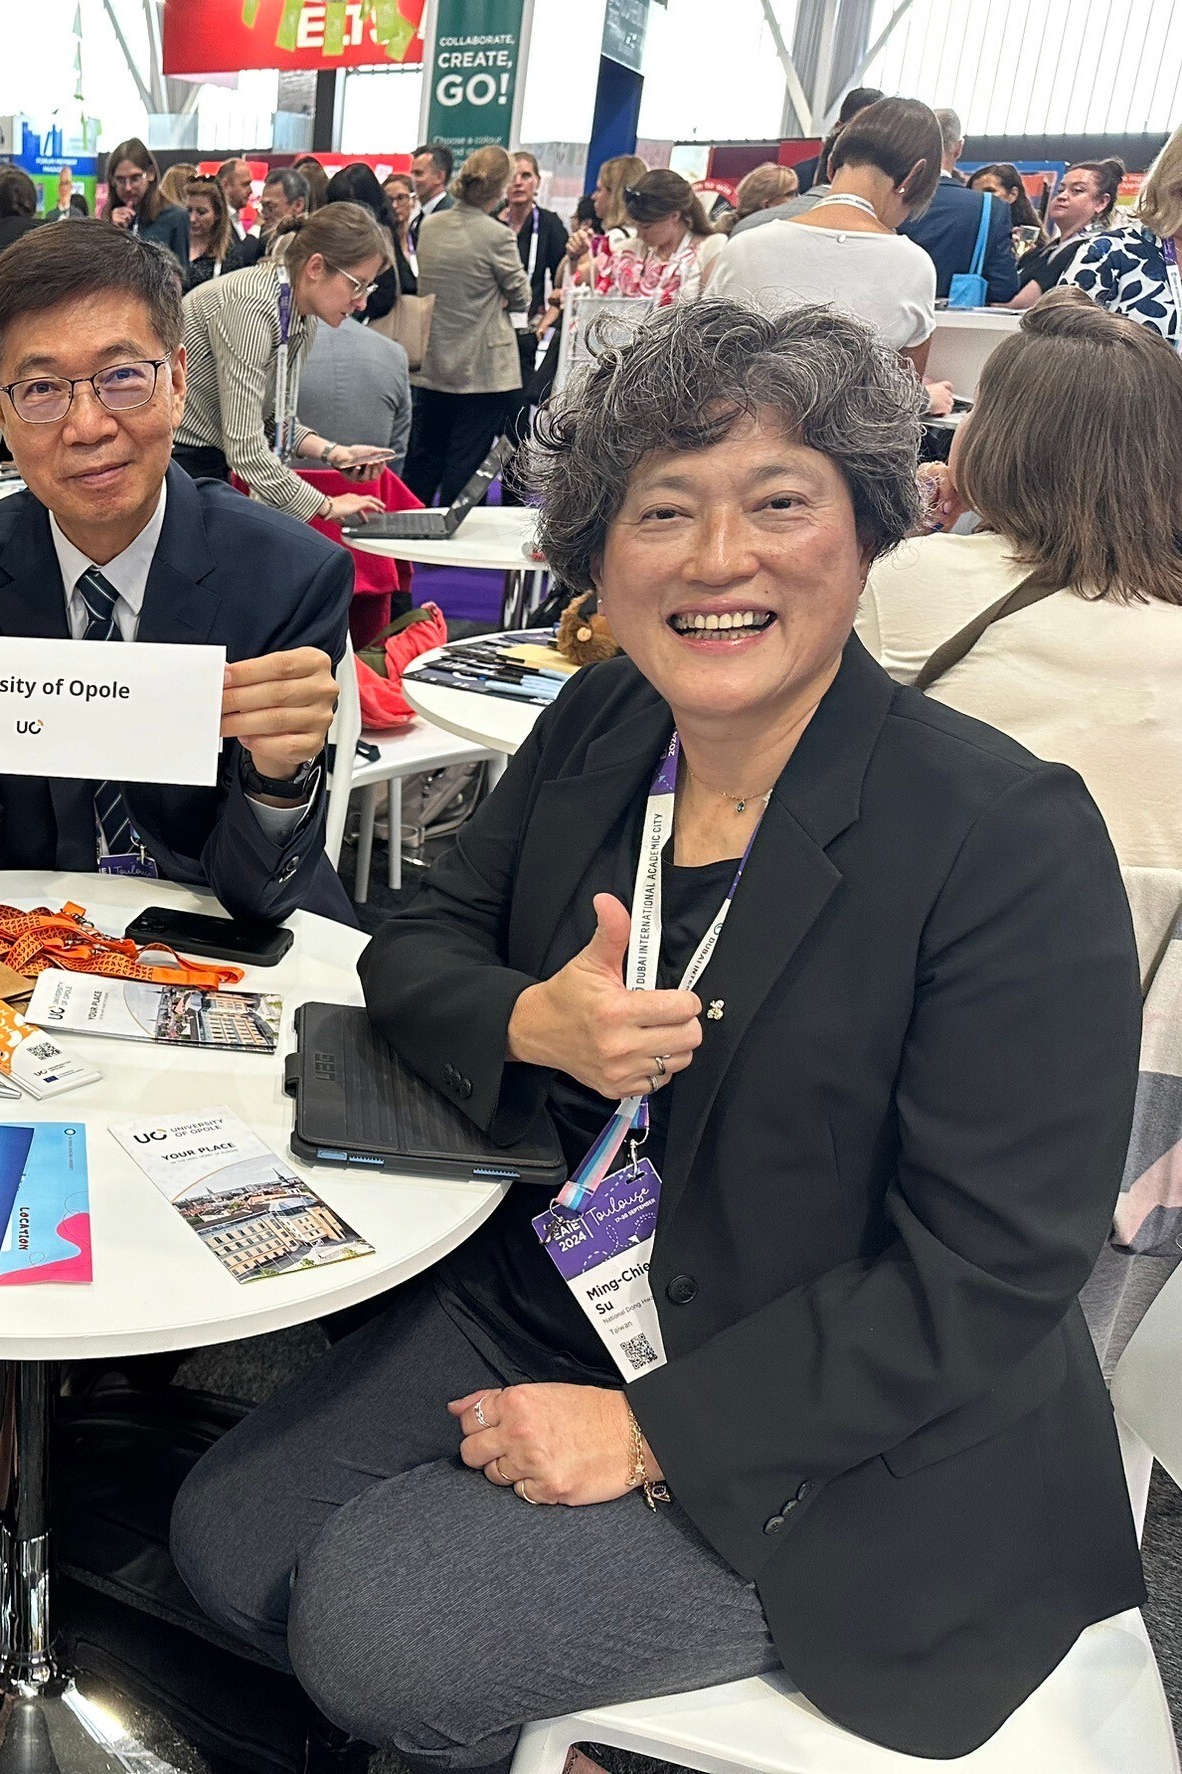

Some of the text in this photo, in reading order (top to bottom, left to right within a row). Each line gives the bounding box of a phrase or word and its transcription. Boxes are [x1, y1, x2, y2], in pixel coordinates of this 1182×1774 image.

[439, 34, 516, 47] COLLABORATE,
[438, 50, 513, 69] CREATE,
[436, 73, 510, 107] GO!
[42, 678, 64, 696] of
[69, 680, 131, 702] Opole
[636, 813, 664, 984] DUBAI INTERNATIONAL ACADEMIC CITY
[696, 937, 716, 965] DUBAI
[87, 990, 103, 1021] YOUR PLACE
[170, 1118, 224, 1133] UNIVERSITY
[190, 1124, 223, 1136] OPOLE
[161, 1141, 237, 1162] YOUR PLACE
[585, 1187, 650, 1226] Toulouse
[628, 1198, 657, 1217] SEPTEMBER
[18, 1206, 31, 1251] LOCATION
[558, 1230, 588, 1252] 2024
[595, 1301, 614, 1315] Su
[602, 1309, 626, 1325] National
[625, 1301, 643, 1313] Dong
[609, 1321, 633, 1336] Taiwan
